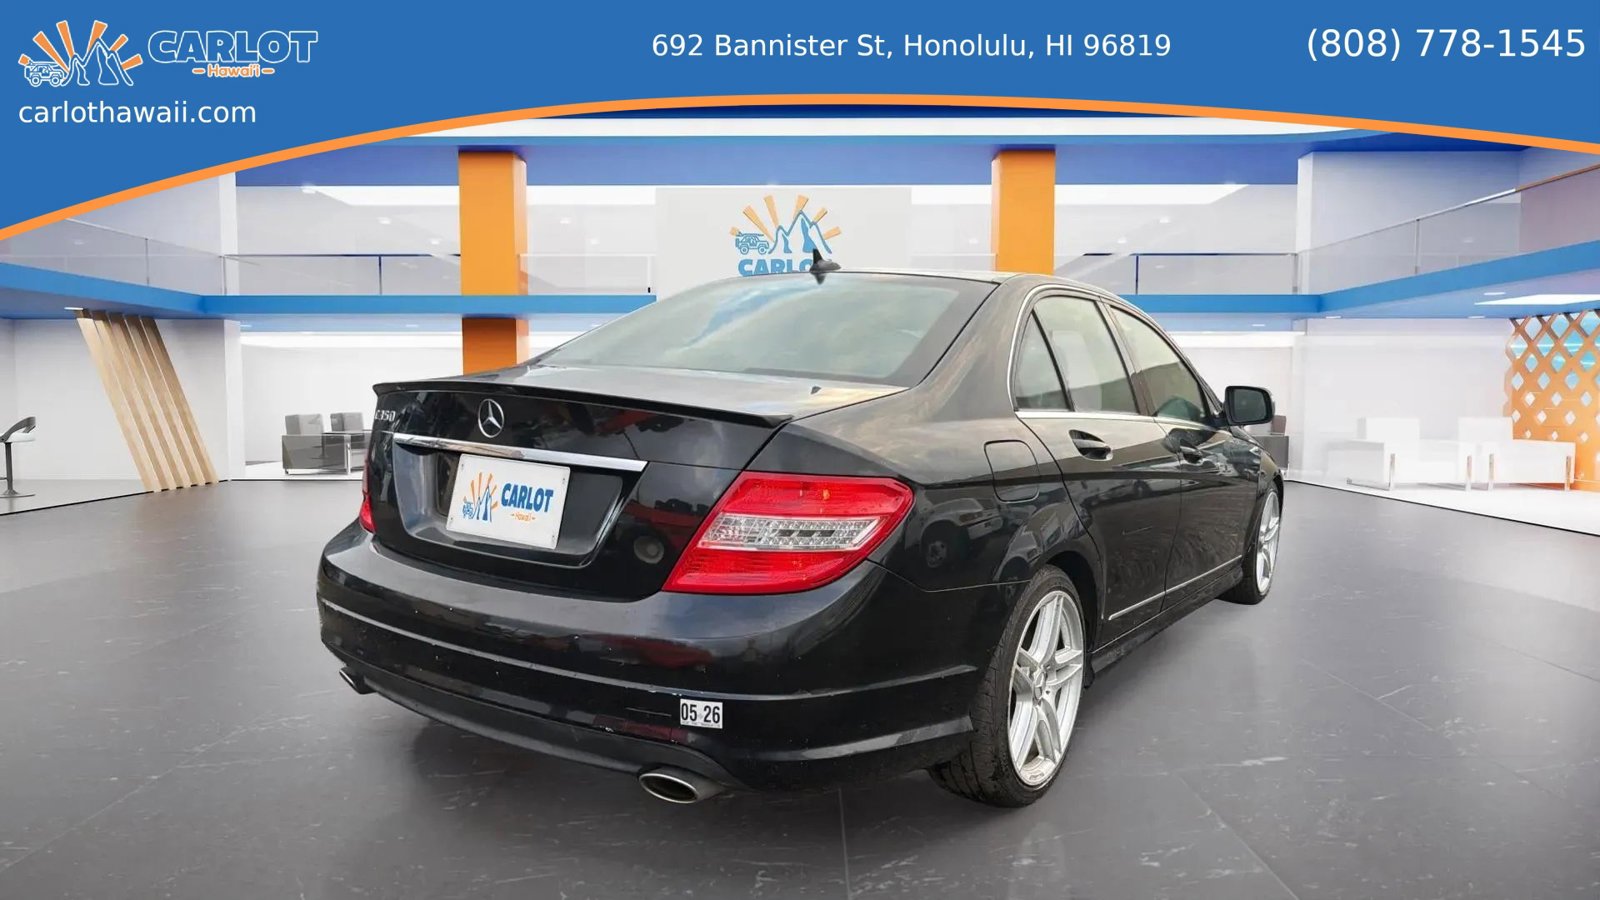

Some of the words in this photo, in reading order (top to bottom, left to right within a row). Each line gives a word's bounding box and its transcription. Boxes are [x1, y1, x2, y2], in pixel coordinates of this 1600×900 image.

[738, 258, 814, 276] CARLO
[501, 483, 554, 513] CARLOT
[681, 703, 697, 721] 05
[703, 705, 720, 723] 26
